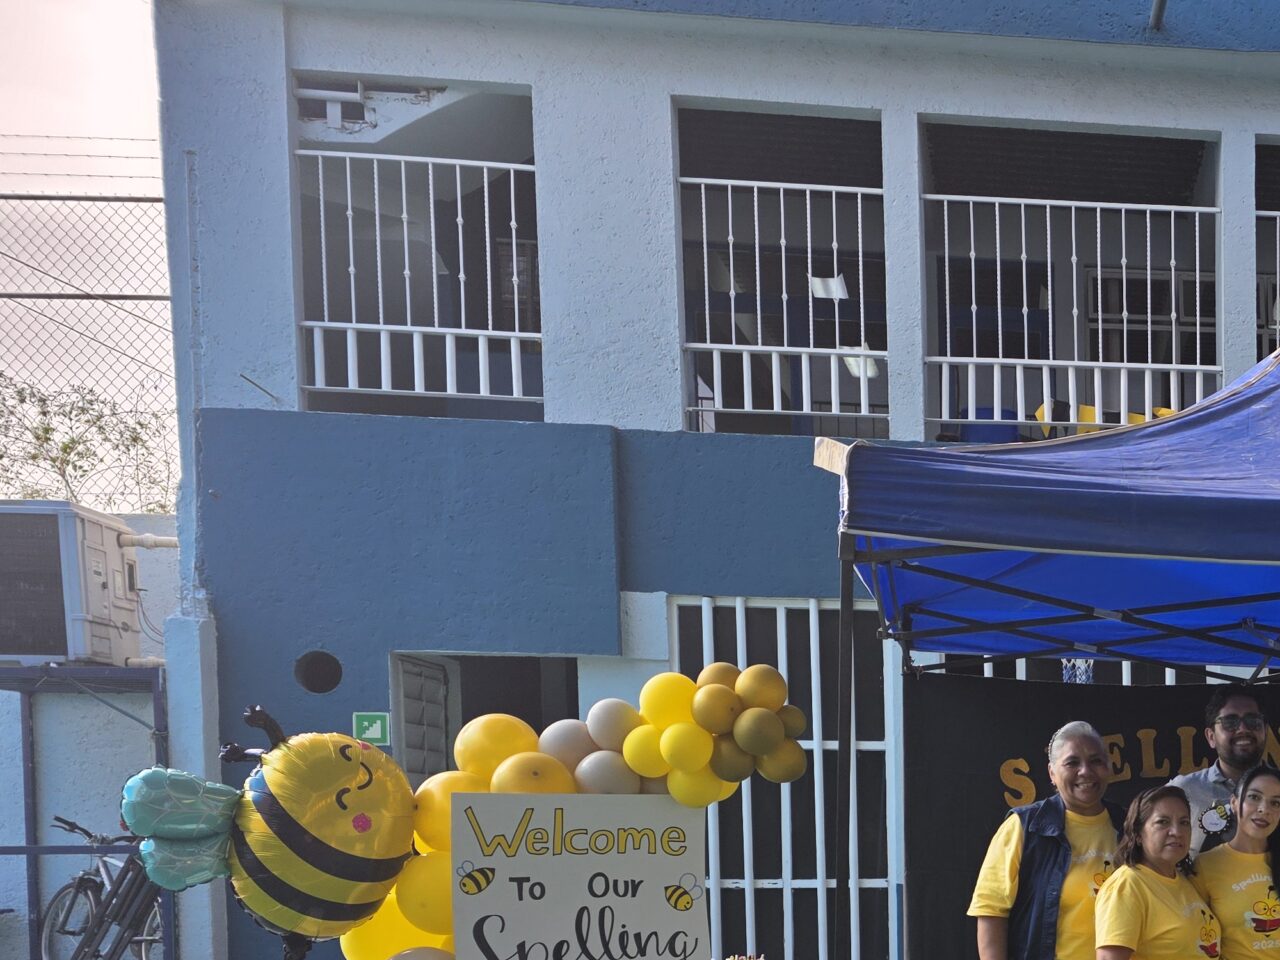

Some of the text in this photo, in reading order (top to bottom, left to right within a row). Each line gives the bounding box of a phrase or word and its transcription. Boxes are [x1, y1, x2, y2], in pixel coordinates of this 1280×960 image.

[464, 805, 688, 858] Welcome
[508, 872, 644, 901] To Our
[1231, 872, 1273, 893] Spellin
